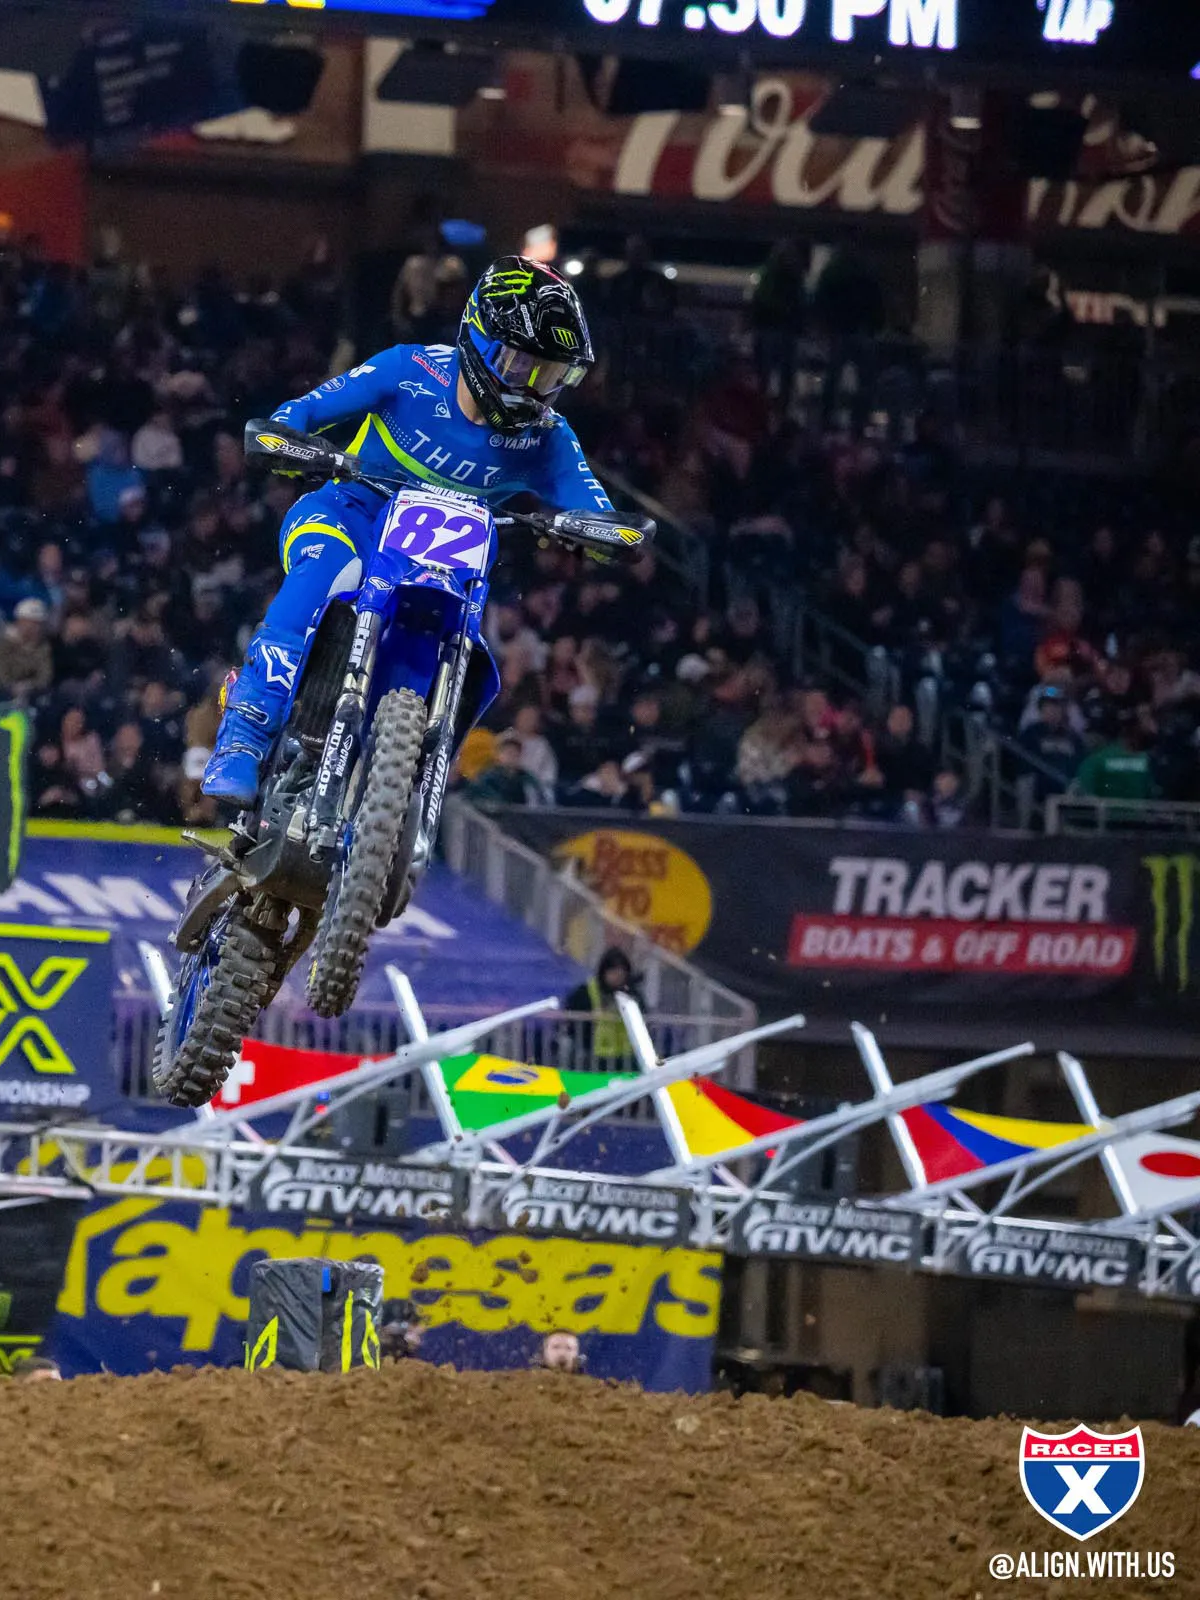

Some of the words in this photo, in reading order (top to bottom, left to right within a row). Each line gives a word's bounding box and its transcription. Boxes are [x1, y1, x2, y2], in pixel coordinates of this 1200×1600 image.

[833, 0, 959, 49] PM
[385, 505, 488, 569] 82
[318, 719, 346, 797] DUNLOP
[427, 744, 448, 826] DUNLOP
[830, 857, 1109, 922] TRACKER
[801, 926, 919, 962] BOATS
[922, 934, 942, 962] &
[955, 930, 1016, 965] OFF
[1027, 933, 1125, 968] ROAD
